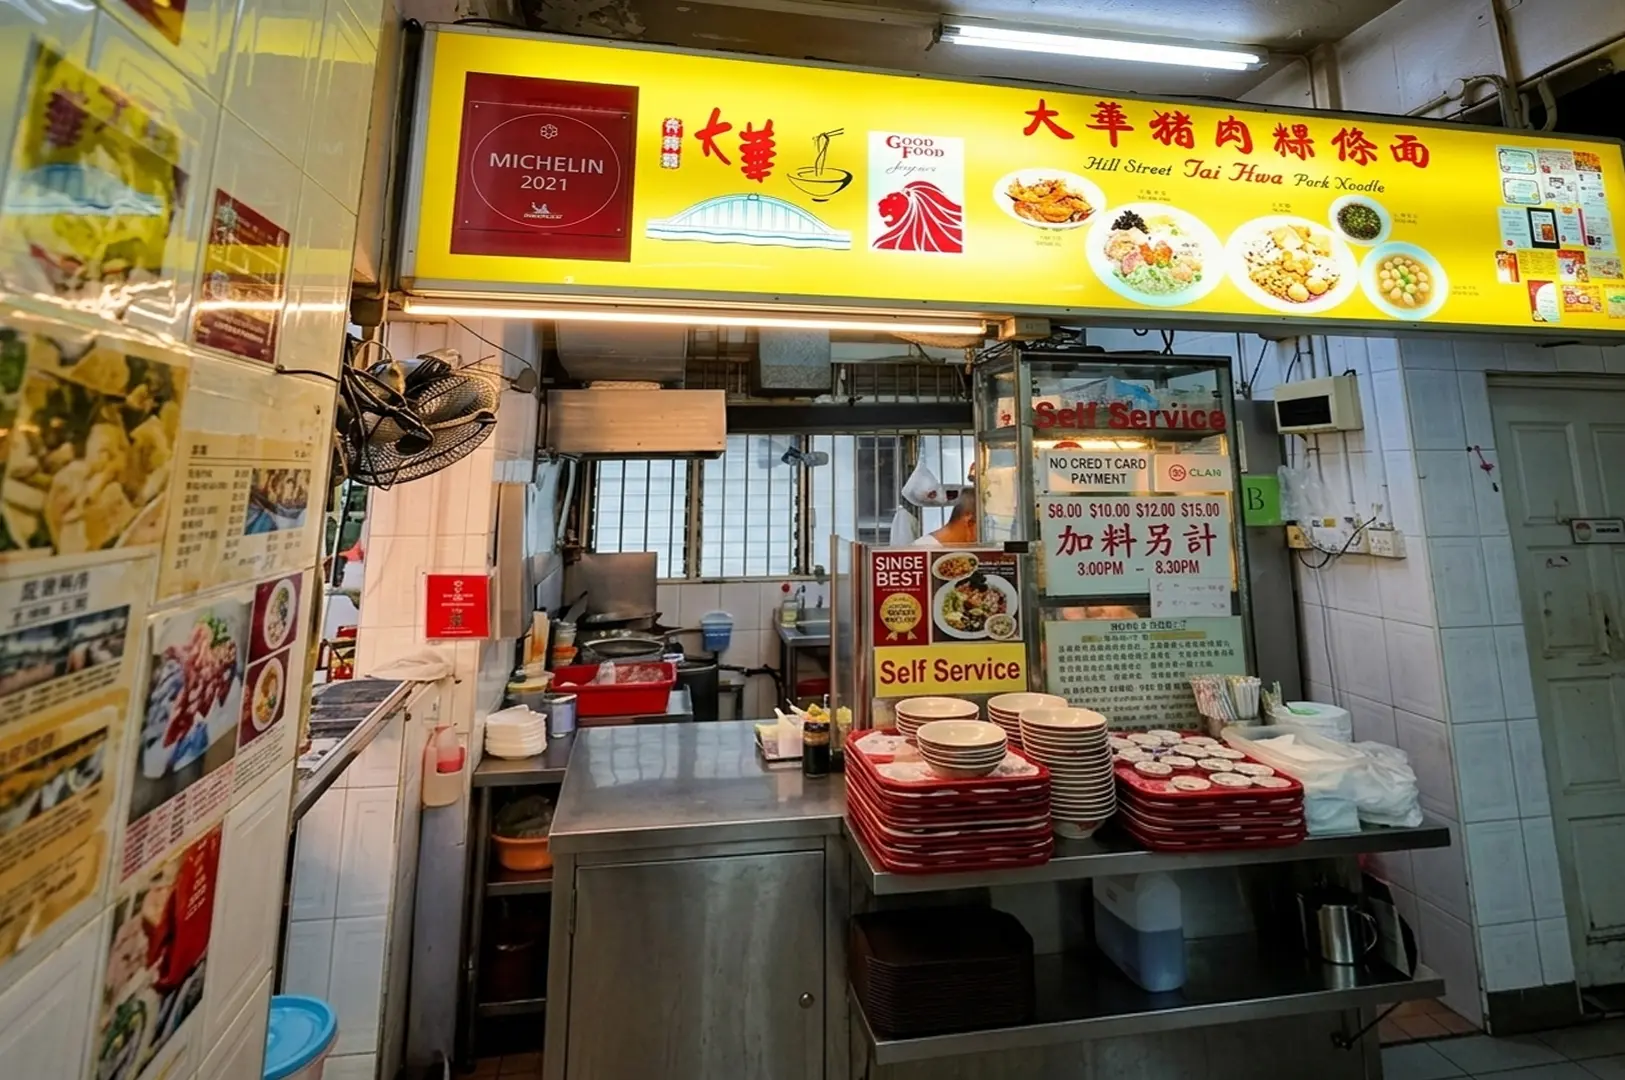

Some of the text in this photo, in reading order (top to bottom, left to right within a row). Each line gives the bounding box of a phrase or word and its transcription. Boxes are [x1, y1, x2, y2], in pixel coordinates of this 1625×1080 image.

[489, 152, 604, 174] MICHELIN
[520, 175, 567, 191] 2021
[1083, 156, 1385, 193] Hill Street Tai Hwa Pork Noodle
[1033, 401, 1227, 431] Self Service
[1050, 458, 1067, 470] NO
[1114, 458, 1147, 470] CARD
[1071, 473, 1127, 485] PAYMENT
[1247, 487, 1264, 510] B
[1090, 503, 1130, 518] $10.00
[1136, 503, 1175, 518] $12.00
[1181, 503, 1219, 517] $15.00
[1056, 523, 1217, 558] 加料另計
[876, 571, 924, 586] BEST
[880, 657, 1021, 684] Self Service
